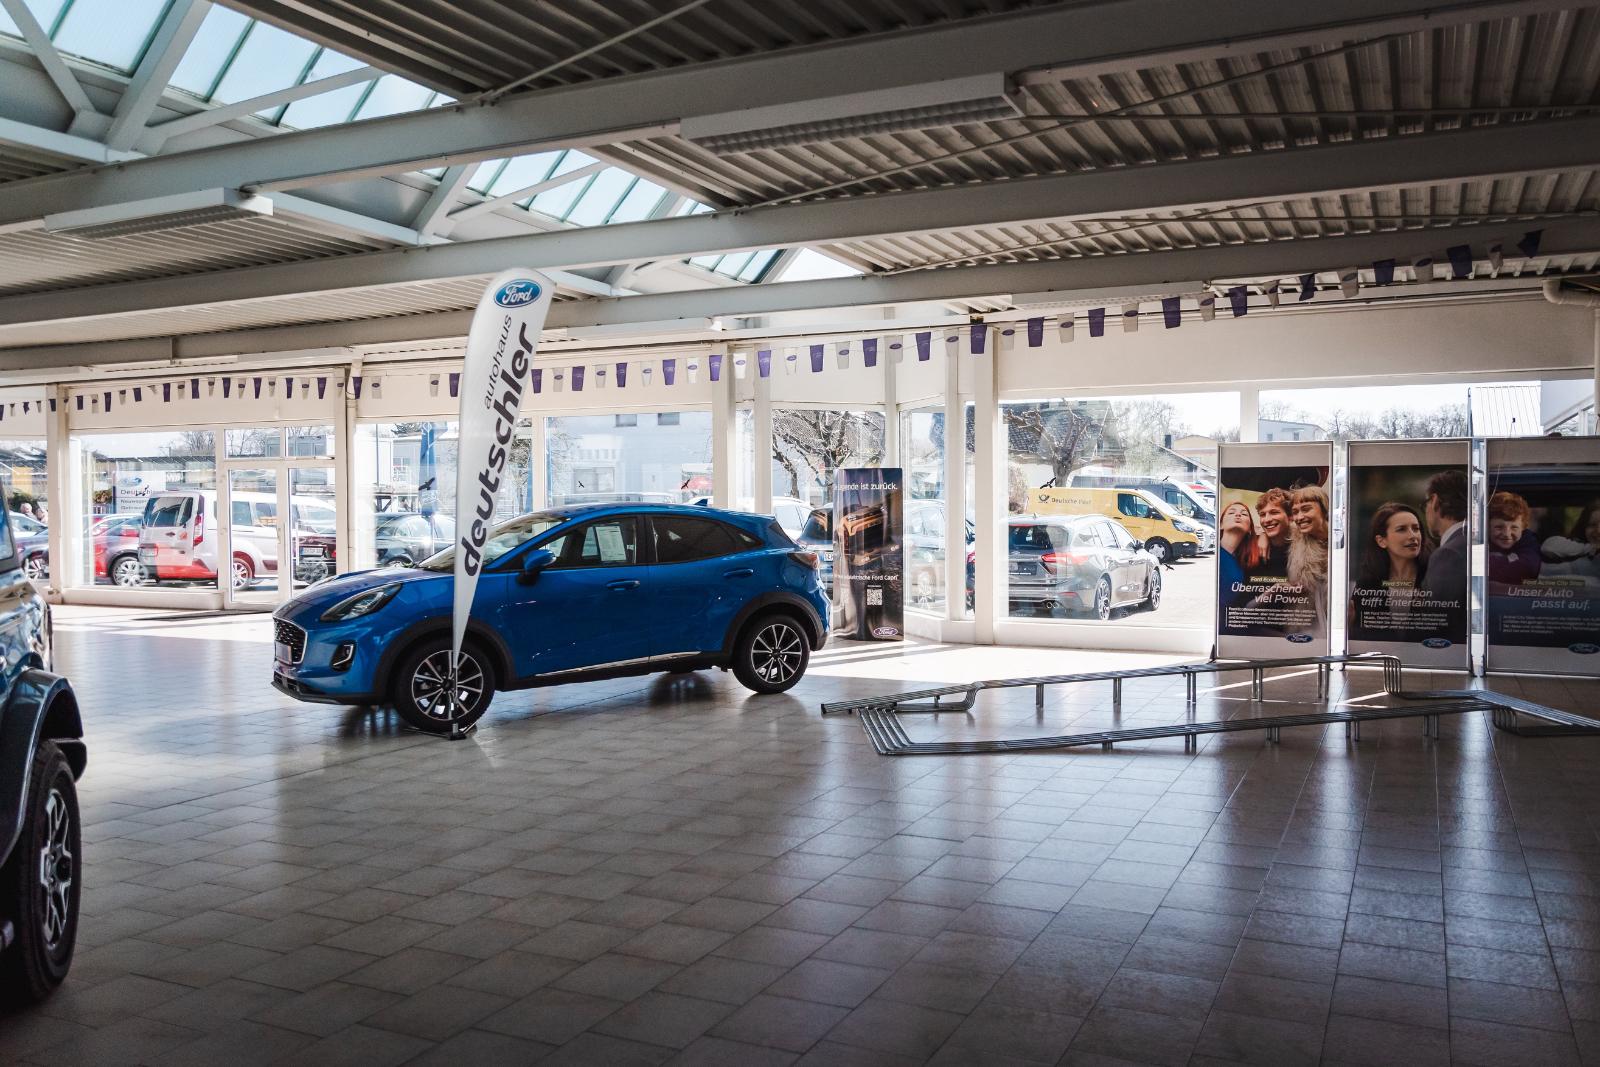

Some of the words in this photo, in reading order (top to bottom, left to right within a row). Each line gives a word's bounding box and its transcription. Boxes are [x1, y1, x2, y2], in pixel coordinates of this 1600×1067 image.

[500, 282, 534, 305] Ford
[483, 314, 513, 411] autohaus
[461, 322, 535, 578] deutschler
[860, 482, 869, 490] ist
[870, 482, 898, 490] zurück.
[1231, 581, 1303, 594] Überraschend
[1353, 588, 1433, 597] Kommunikation
[1507, 587, 1542, 597] Unser
[1544, 588, 1575, 598] Auto
[1254, 594, 1273, 603] viel
[1274, 594, 1310, 604] Power.
[1361, 598, 1383, 608] trifft
[1384, 599, 1461, 608] Entertainment.
[1531, 599, 1567, 609] passt
[1567, 599, 1590, 611] auf.
